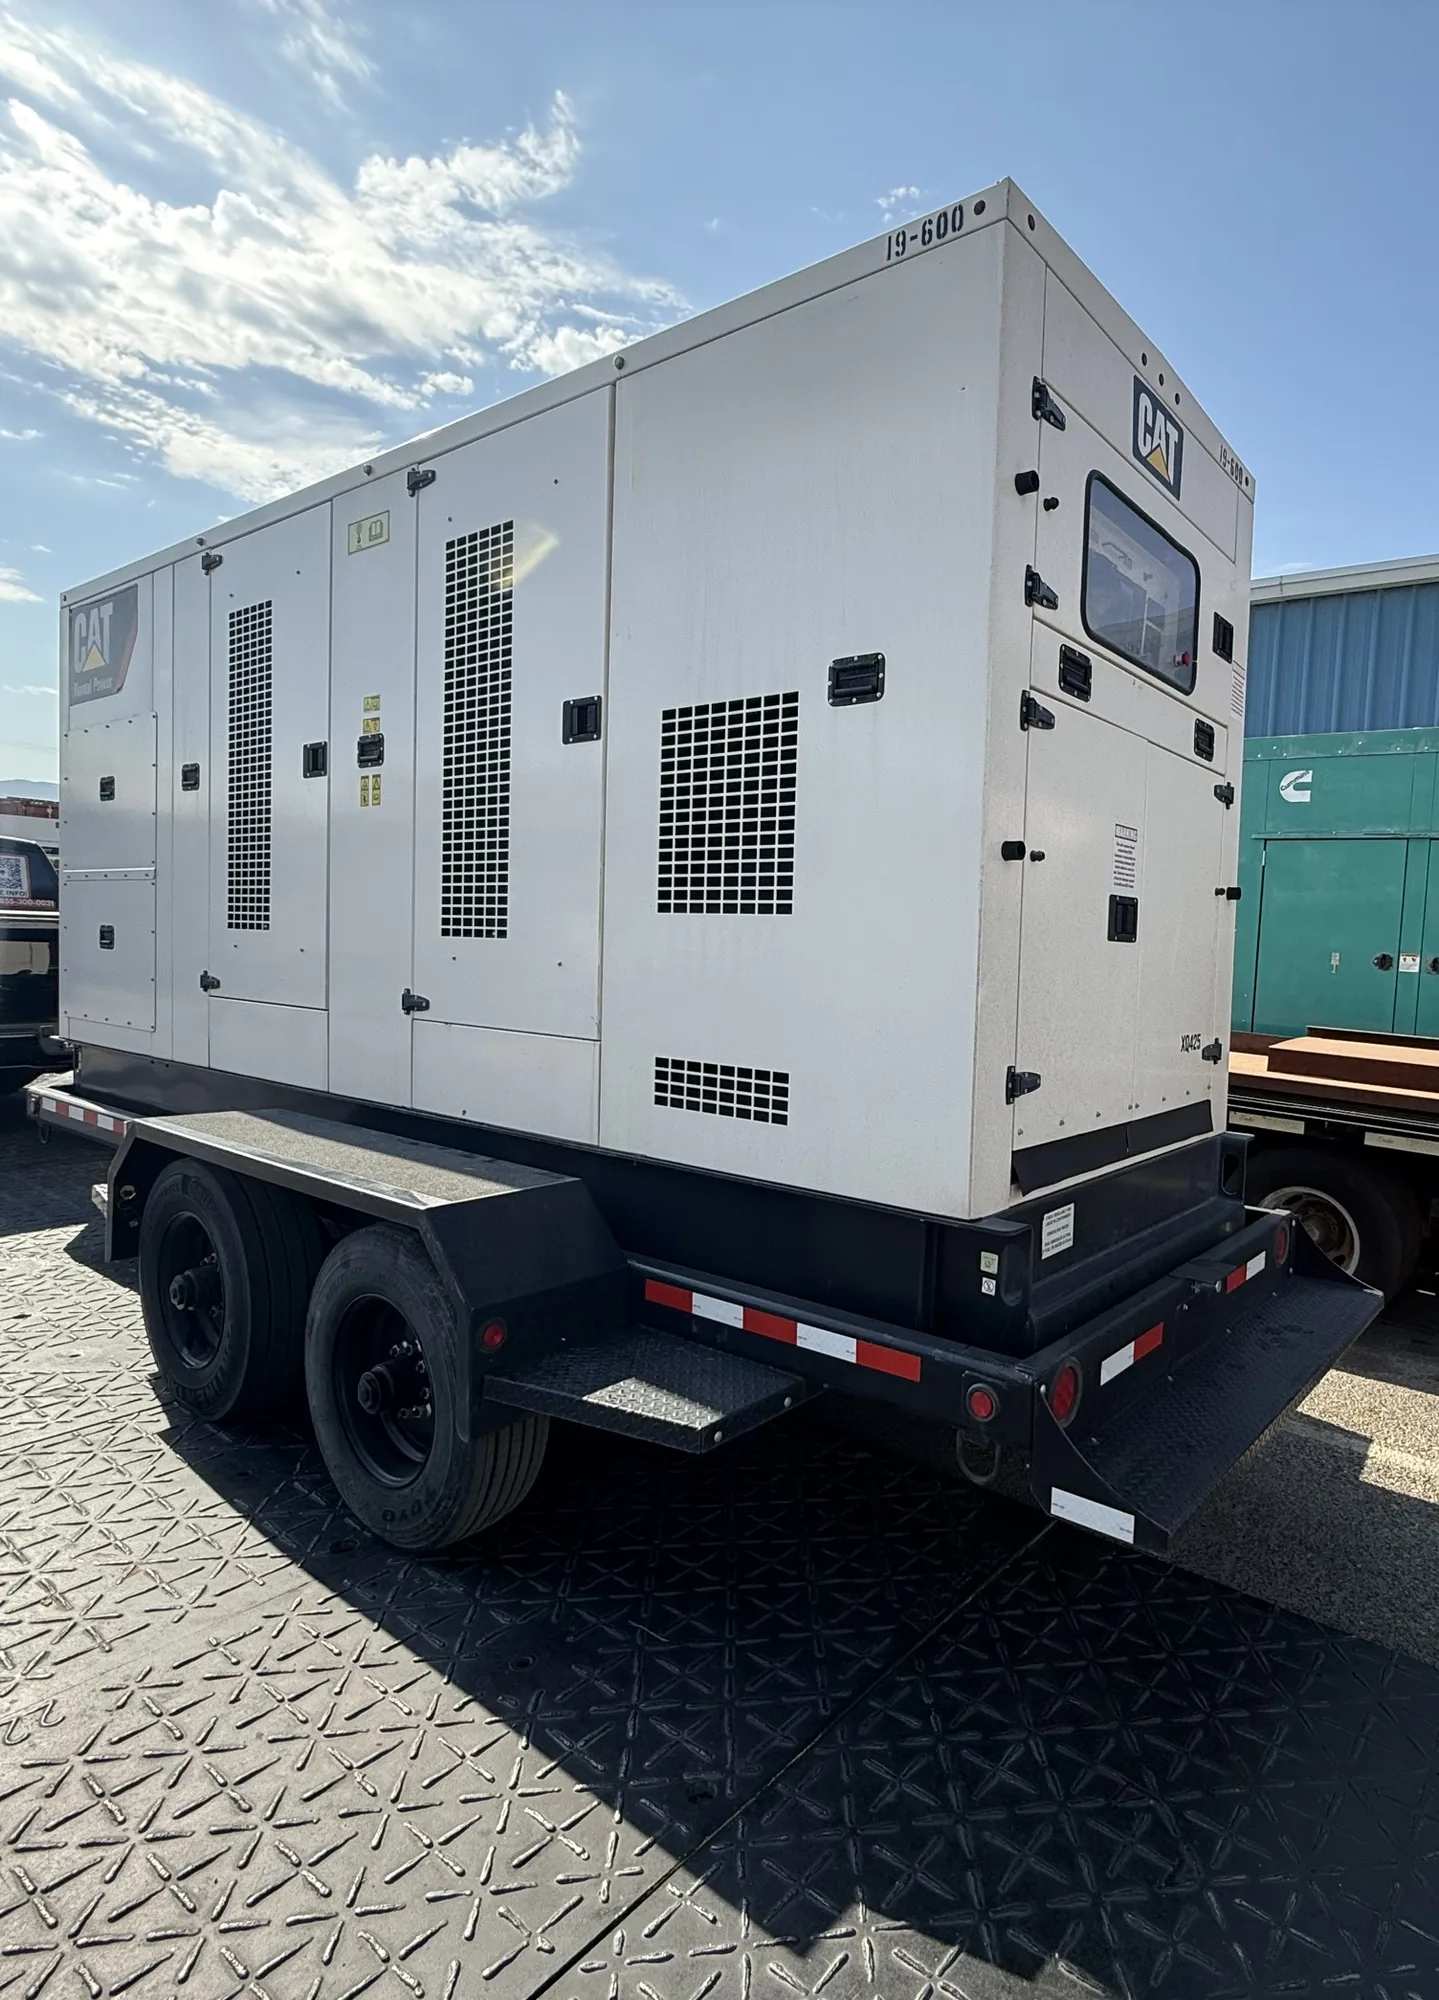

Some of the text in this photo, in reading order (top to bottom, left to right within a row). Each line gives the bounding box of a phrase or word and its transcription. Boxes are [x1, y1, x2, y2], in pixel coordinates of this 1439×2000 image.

[887, 204, 964, 261] 19-600
[1137, 392, 1180, 486] CAT
[1219, 444, 1244, 487] 19-600
[73, 602, 113, 673] CAT
